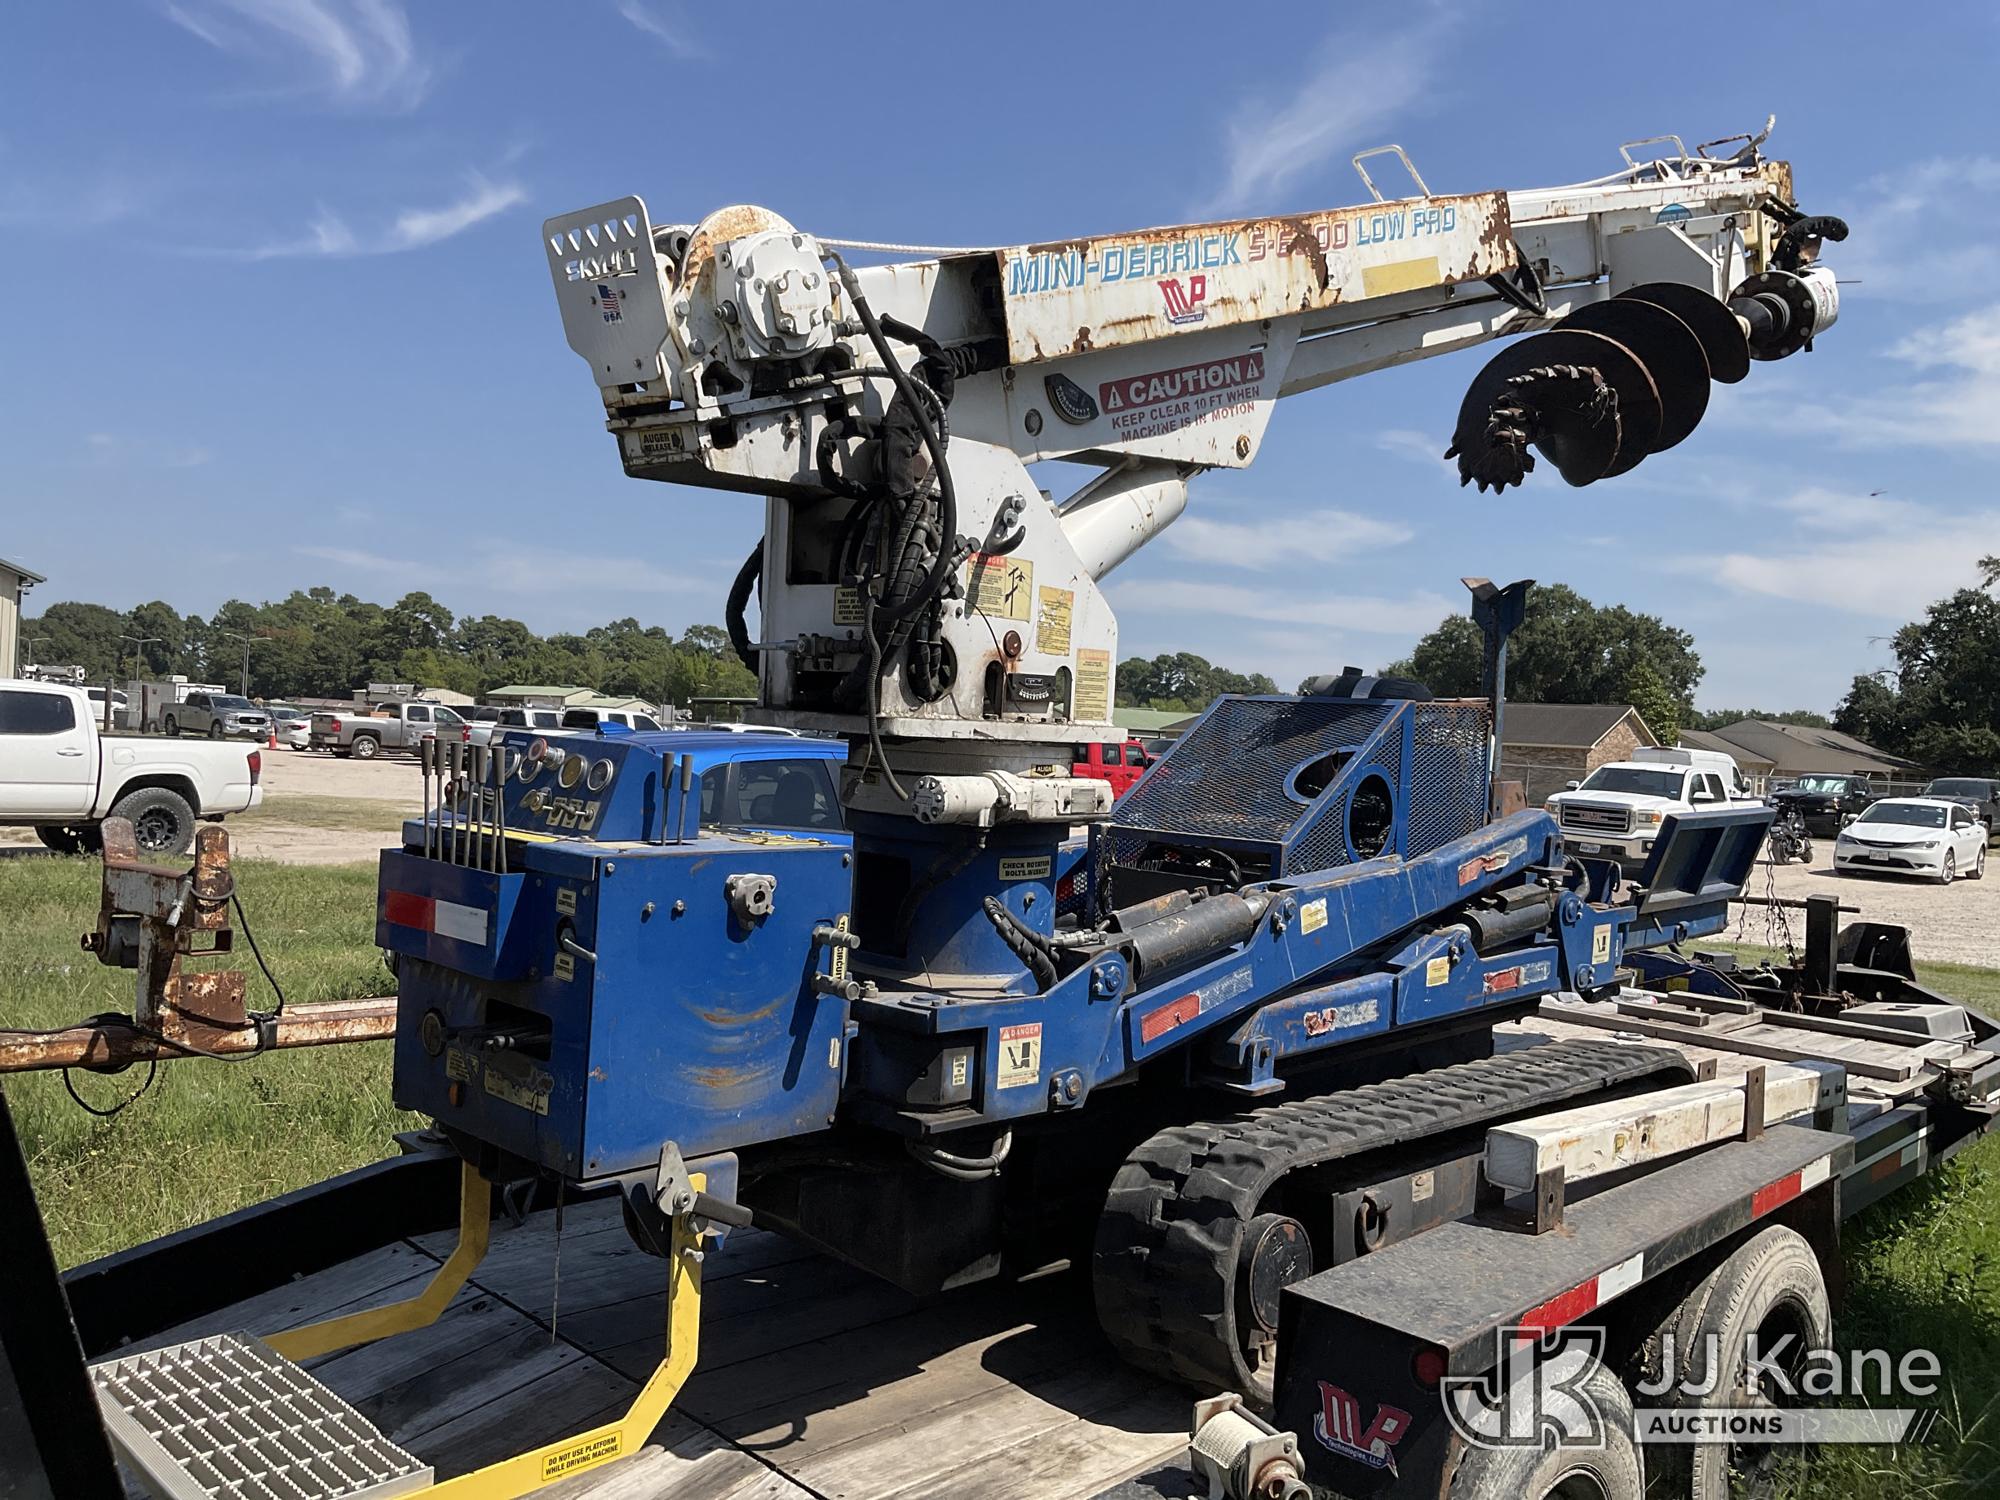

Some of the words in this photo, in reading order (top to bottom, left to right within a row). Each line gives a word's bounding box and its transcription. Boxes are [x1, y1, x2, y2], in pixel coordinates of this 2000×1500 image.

[1009, 232, 1241, 296] MINI-DERRICK
[1355, 210, 1406, 247] LOW
[1129, 361, 1241, 404] CAUTION
[1112, 411, 1146, 429] KEEP
[1150, 402, 1190, 420] CLEAR
[1194, 399, 1207, 411] 10
[1209, 395, 1222, 407] FT
[1226, 385, 1260, 402] WHEN
[1121, 420, 1177, 443] MACHINE
[1181, 417, 1191, 428] IS
[1195, 413, 1206, 425] IN
[1211, 402, 1255, 422] MOTION
[643, 432, 670, 443] AUGER
[545, 1463, 565, 1475] WHILE
[566, 1454, 590, 1468] DRIVING
[591, 1444, 618, 1459] MACHINE
[548, 1457, 557, 1466] DO
[558, 1452, 570, 1462] NOT
[572, 1448, 584, 1457] USE
[585, 1436, 616, 1452] PLATFORM
[1328, 1439, 1368, 1461] Technologies,
[1369, 1455, 1382, 1466] LLC
